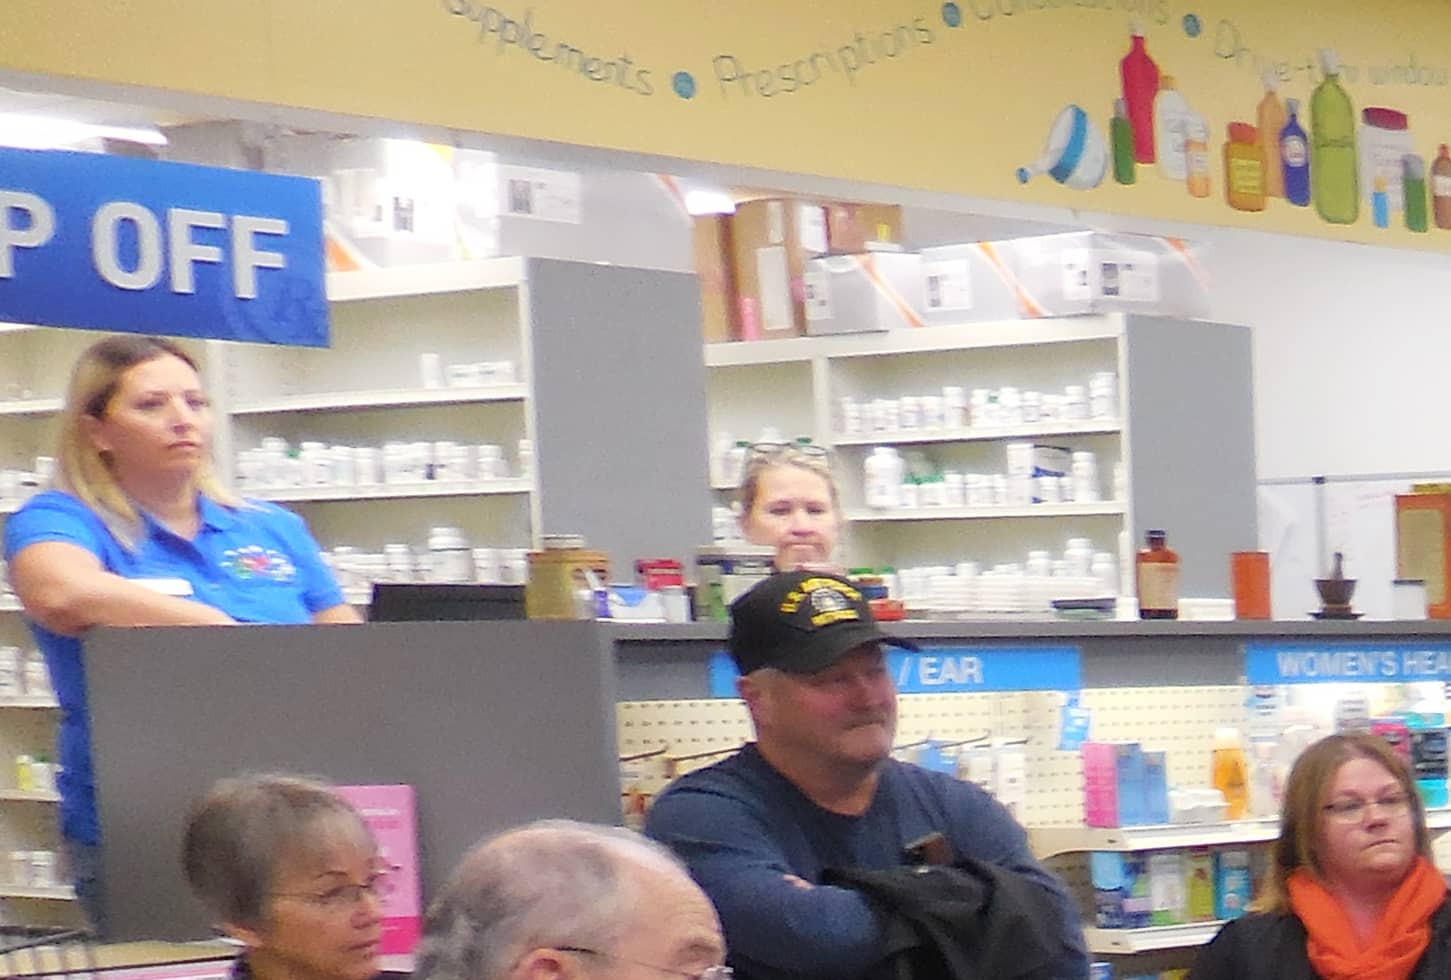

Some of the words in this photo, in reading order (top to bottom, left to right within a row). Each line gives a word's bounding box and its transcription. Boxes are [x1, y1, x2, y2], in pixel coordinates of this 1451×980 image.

[712, 17, 936, 99] Prescriptions
[92, 200, 289, 299] OFF
[919, 656, 984, 686] EAR
[1276, 651, 1397, 677] WOMEN'S
